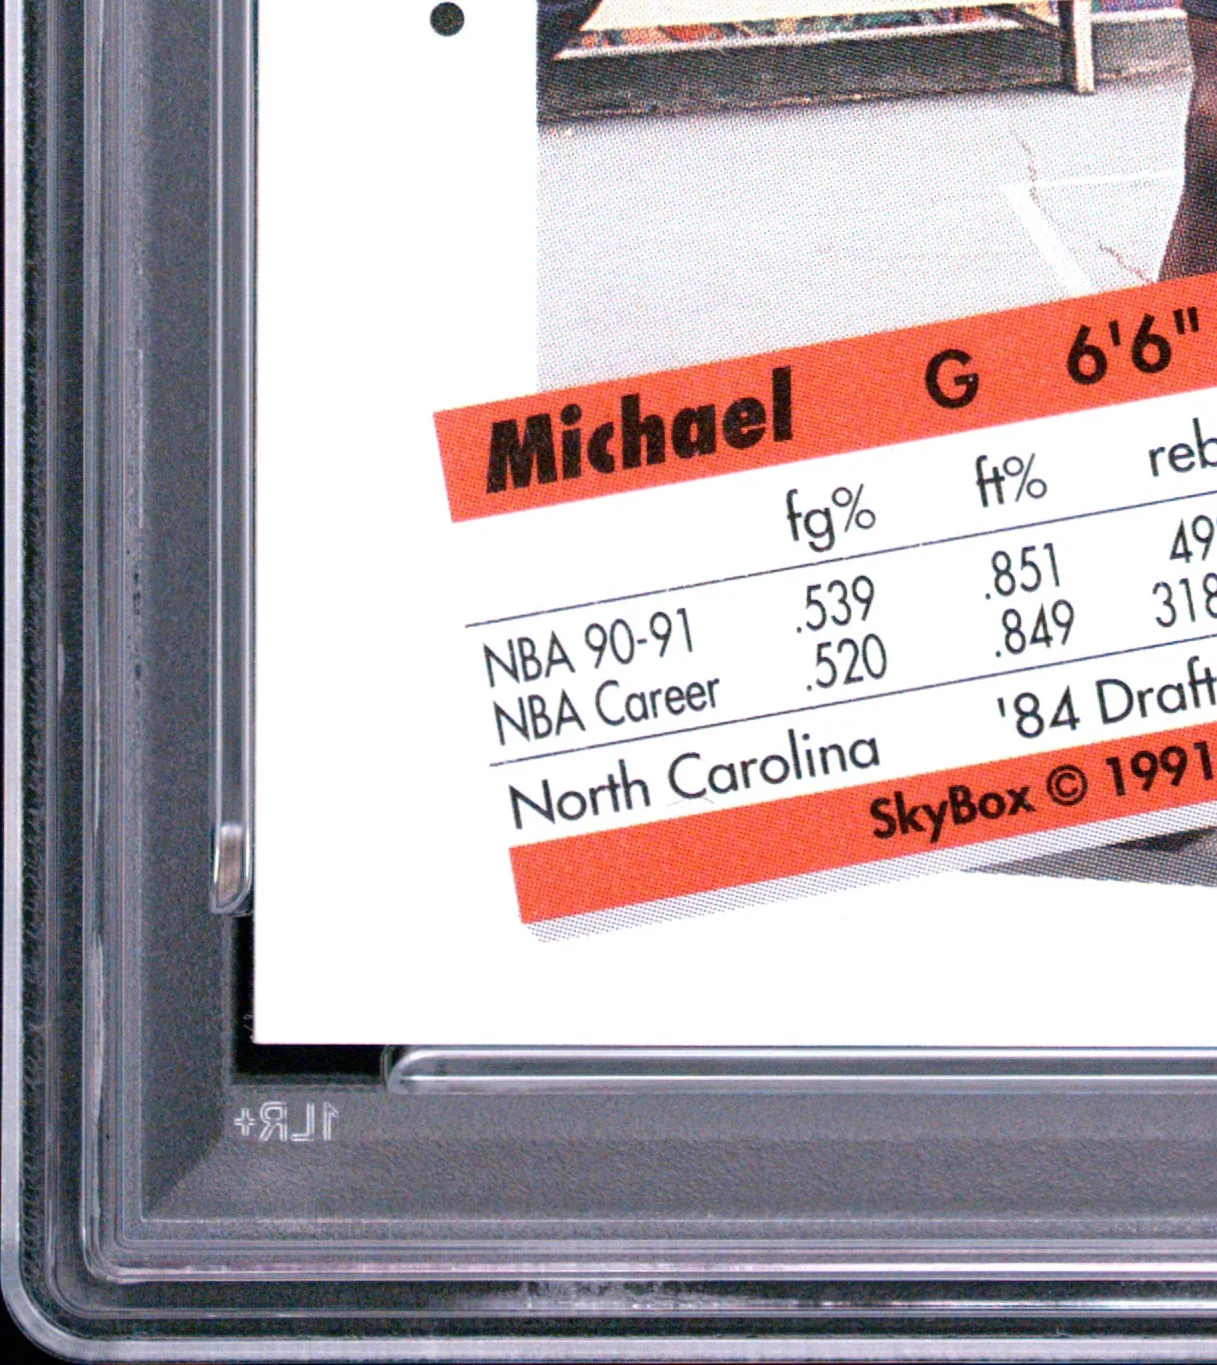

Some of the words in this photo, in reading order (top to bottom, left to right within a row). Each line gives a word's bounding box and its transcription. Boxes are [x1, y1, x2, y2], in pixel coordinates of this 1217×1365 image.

[485, 365, 794, 495] Michael
[923, 348, 980, 410] G
[1065, 305, 1200, 386] 6'6"
[785, 483, 877, 554] fg%
[974, 454, 1048, 508] ft%
[482, 631, 576, 688] NBA
[584, 607, 693, 670] 90-91
[795, 574, 875, 632] .539
[982, 542, 1061, 597] .851
[493, 689, 587, 746] NBA
[594, 677, 721, 727] Career
[803, 632, 888, 689] .520
[992, 599, 1075, 655] .849
[508, 758, 651, 830] North
[667, 719, 881, 800] Carolina
[996, 685, 1081, 739] '84
[868, 784, 1037, 845] SkyBox
[1045, 763, 1089, 807] ©
[1104, 740, 1214, 798] 1991
